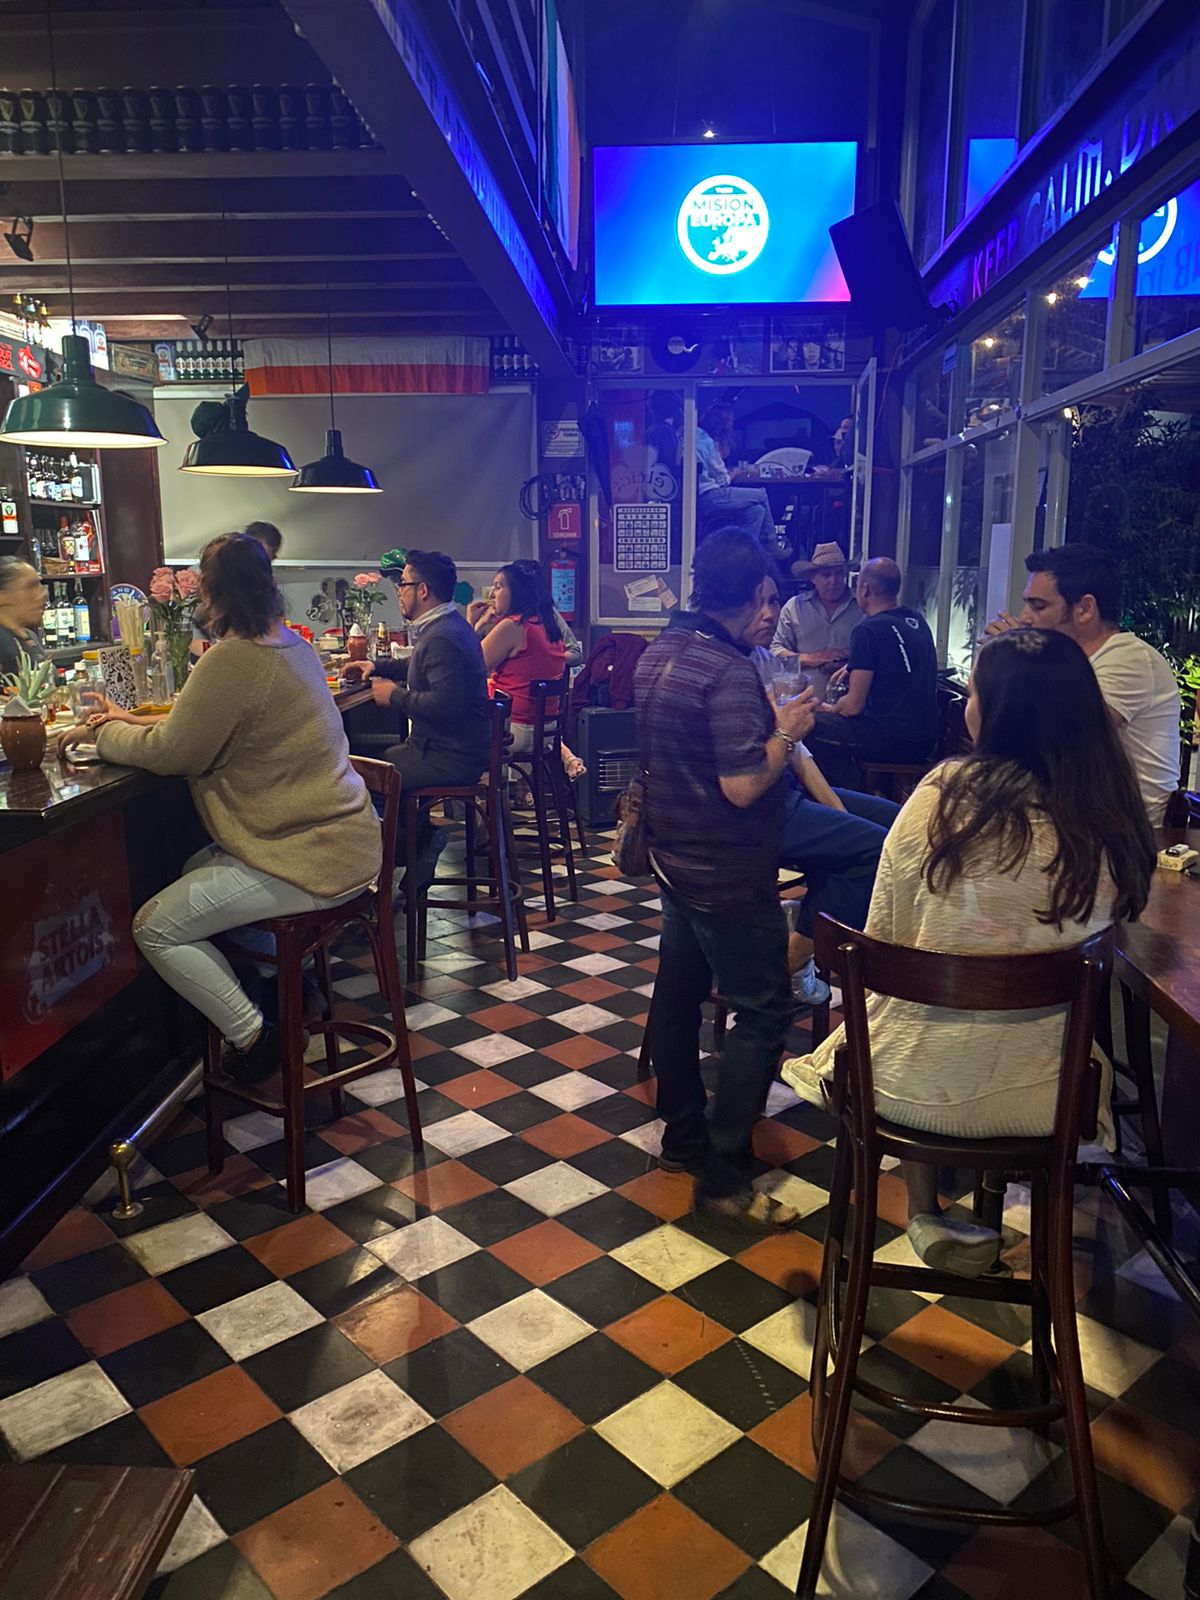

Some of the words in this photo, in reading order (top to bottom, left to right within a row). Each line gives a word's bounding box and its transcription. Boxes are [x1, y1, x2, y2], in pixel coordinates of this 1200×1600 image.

[690, 213, 758, 228] EUROPA
[38, 905, 102, 962] STELLA
[41, 934, 104, 993] ARTOIS
